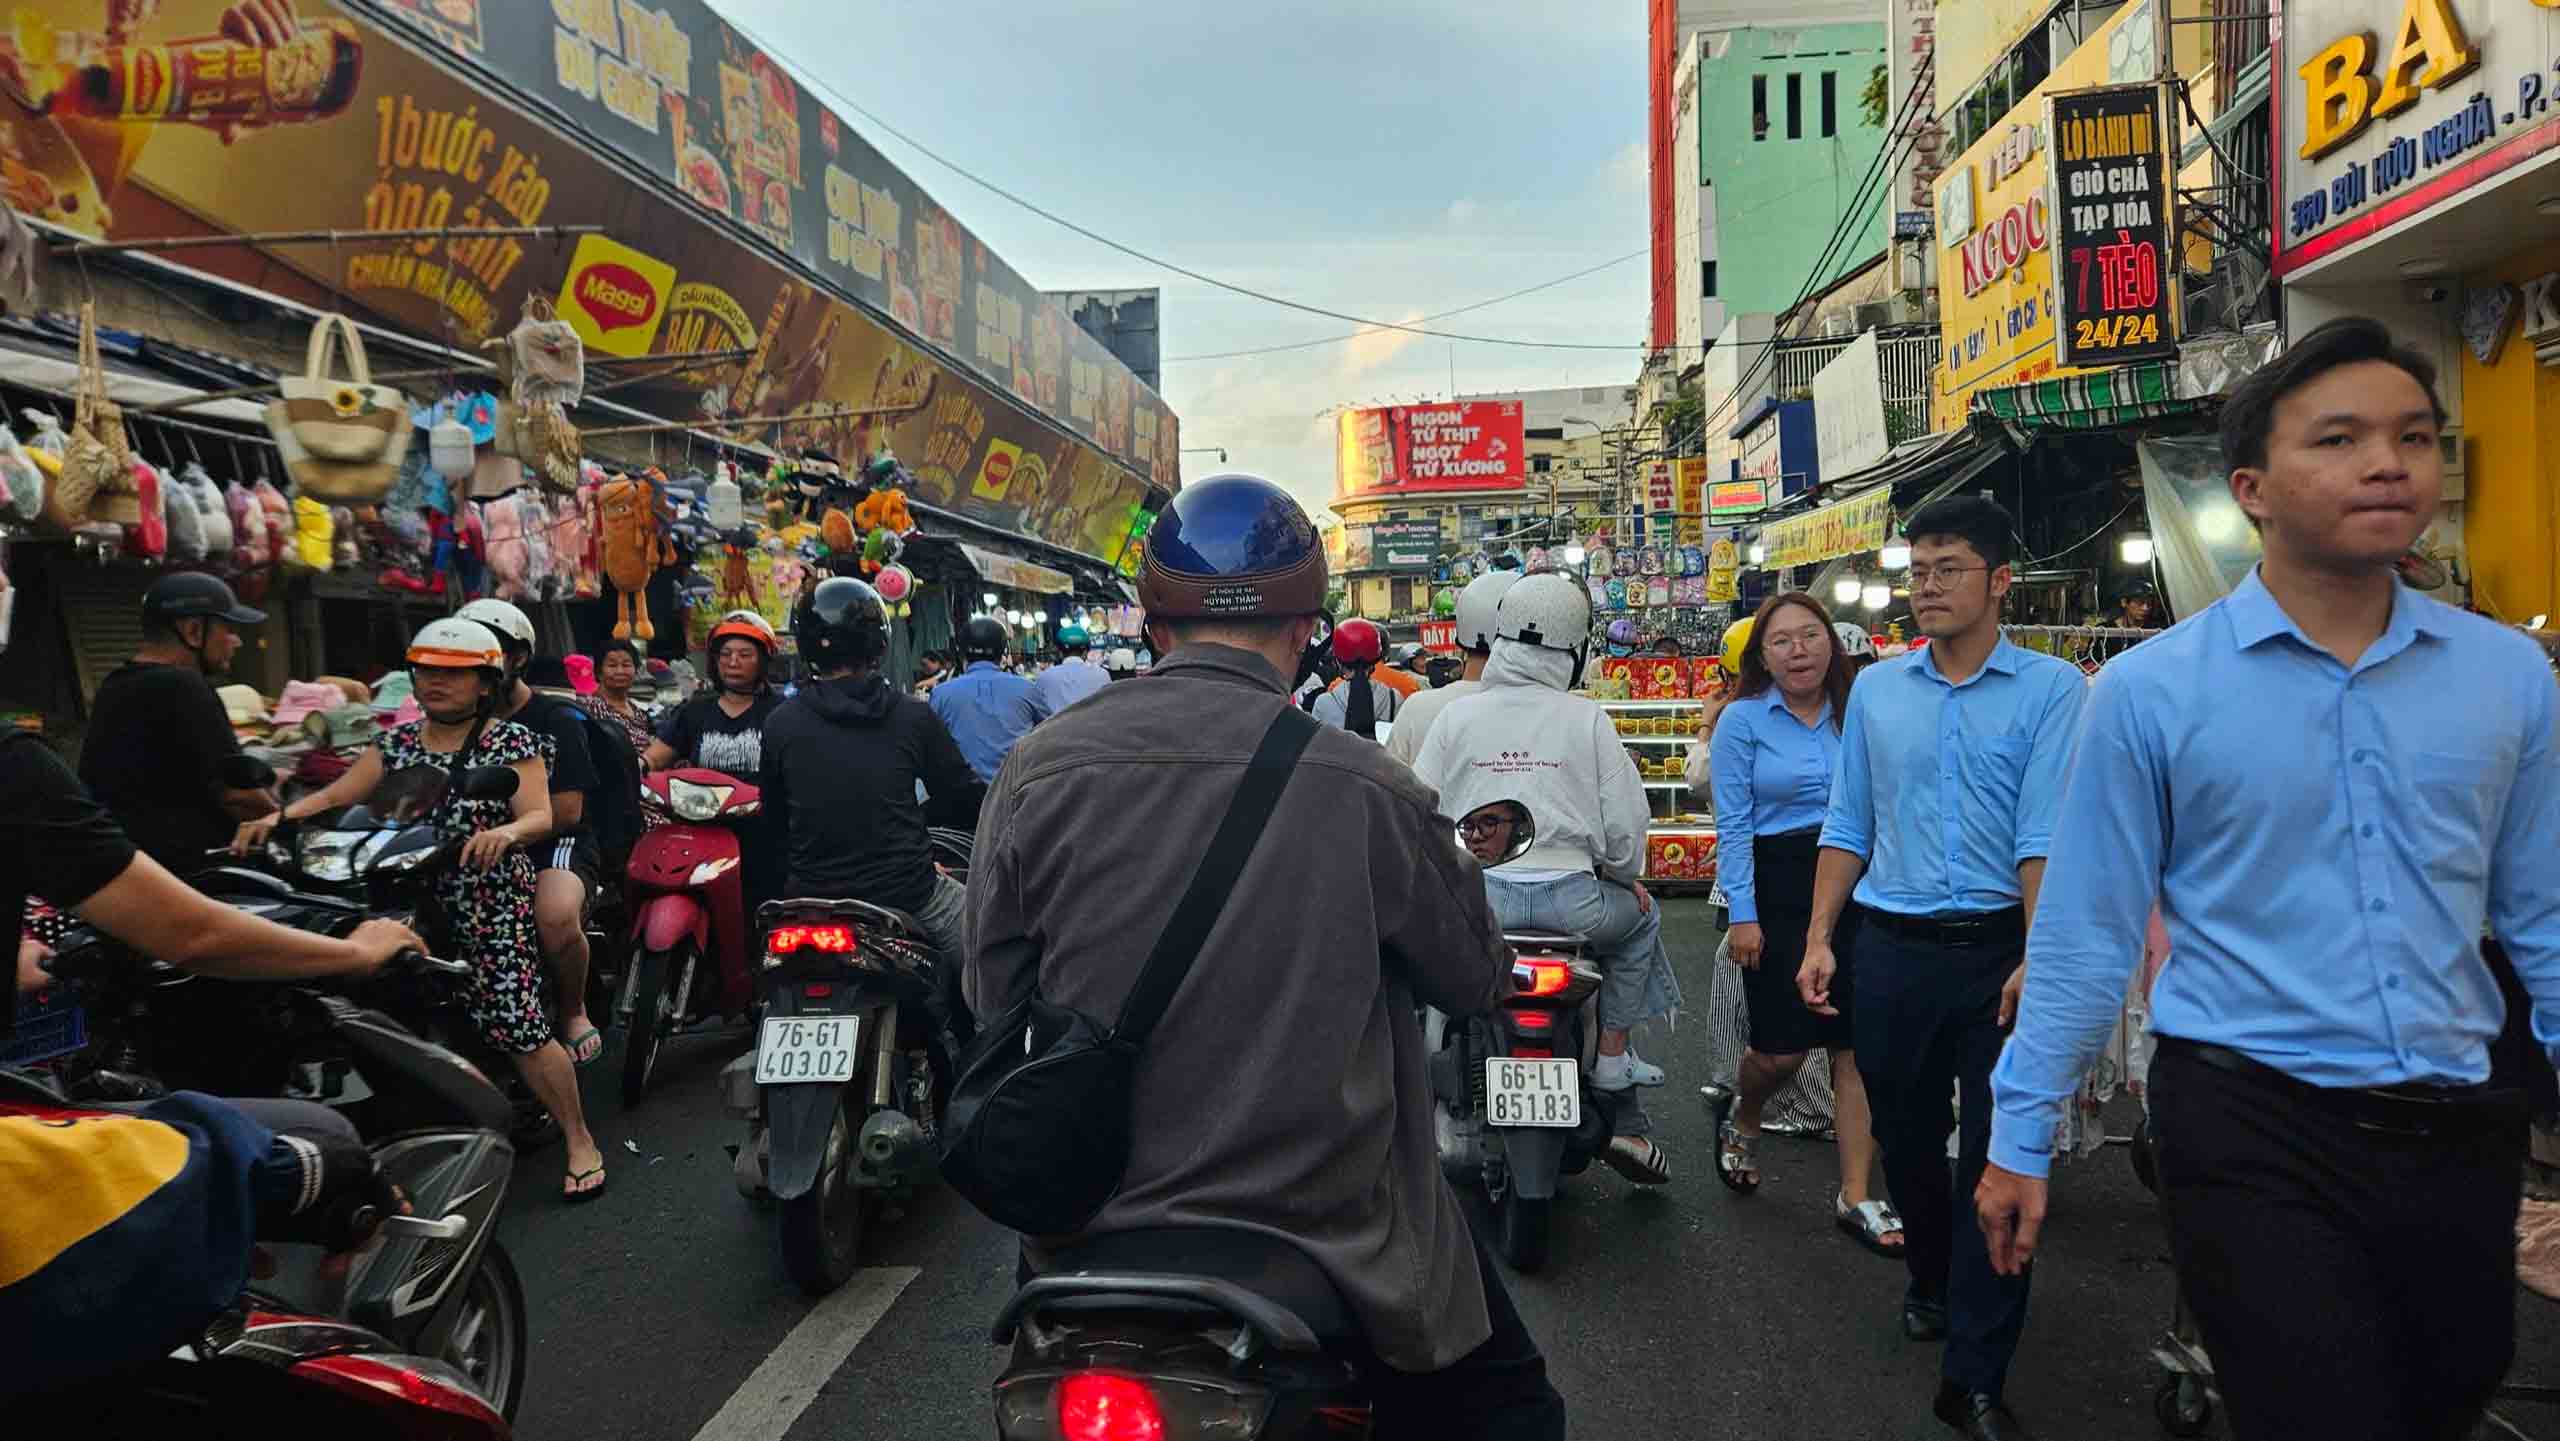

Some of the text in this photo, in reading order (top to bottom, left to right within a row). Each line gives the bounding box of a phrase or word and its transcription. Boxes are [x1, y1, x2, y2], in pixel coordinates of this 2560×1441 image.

[2297, 0, 2478, 161] BA
[393, 95, 496, 183] bước
[2063, 103, 2153, 161] LÒ BÁNH MÌ
[2070, 155, 2150, 198] GIÒ CHẢ
[2290, 188, 2328, 237] 360
[2331, 160, 2367, 216] BÙI
[2372, 135, 2417, 196] HỮU
[2422, 90, 2496, 170] NGHĨA
[2071, 196, 2152, 237] TẠP HÓA
[1961, 187, 2050, 299] NGỌC
[2071, 248, 2090, 313] 7
[2096, 229, 2158, 311] TÈO
[583, 275, 649, 318] Maggi
[2076, 314, 2159, 350] 24/24
[1411, 411, 1462, 426] NGON
[777, 1022, 841, 1048] 76-G1
[764, 1050, 848, 1078] 403.02
[1501, 1063, 1563, 1091] 66-L1
[1495, 1093, 1572, 1121] 851.83
